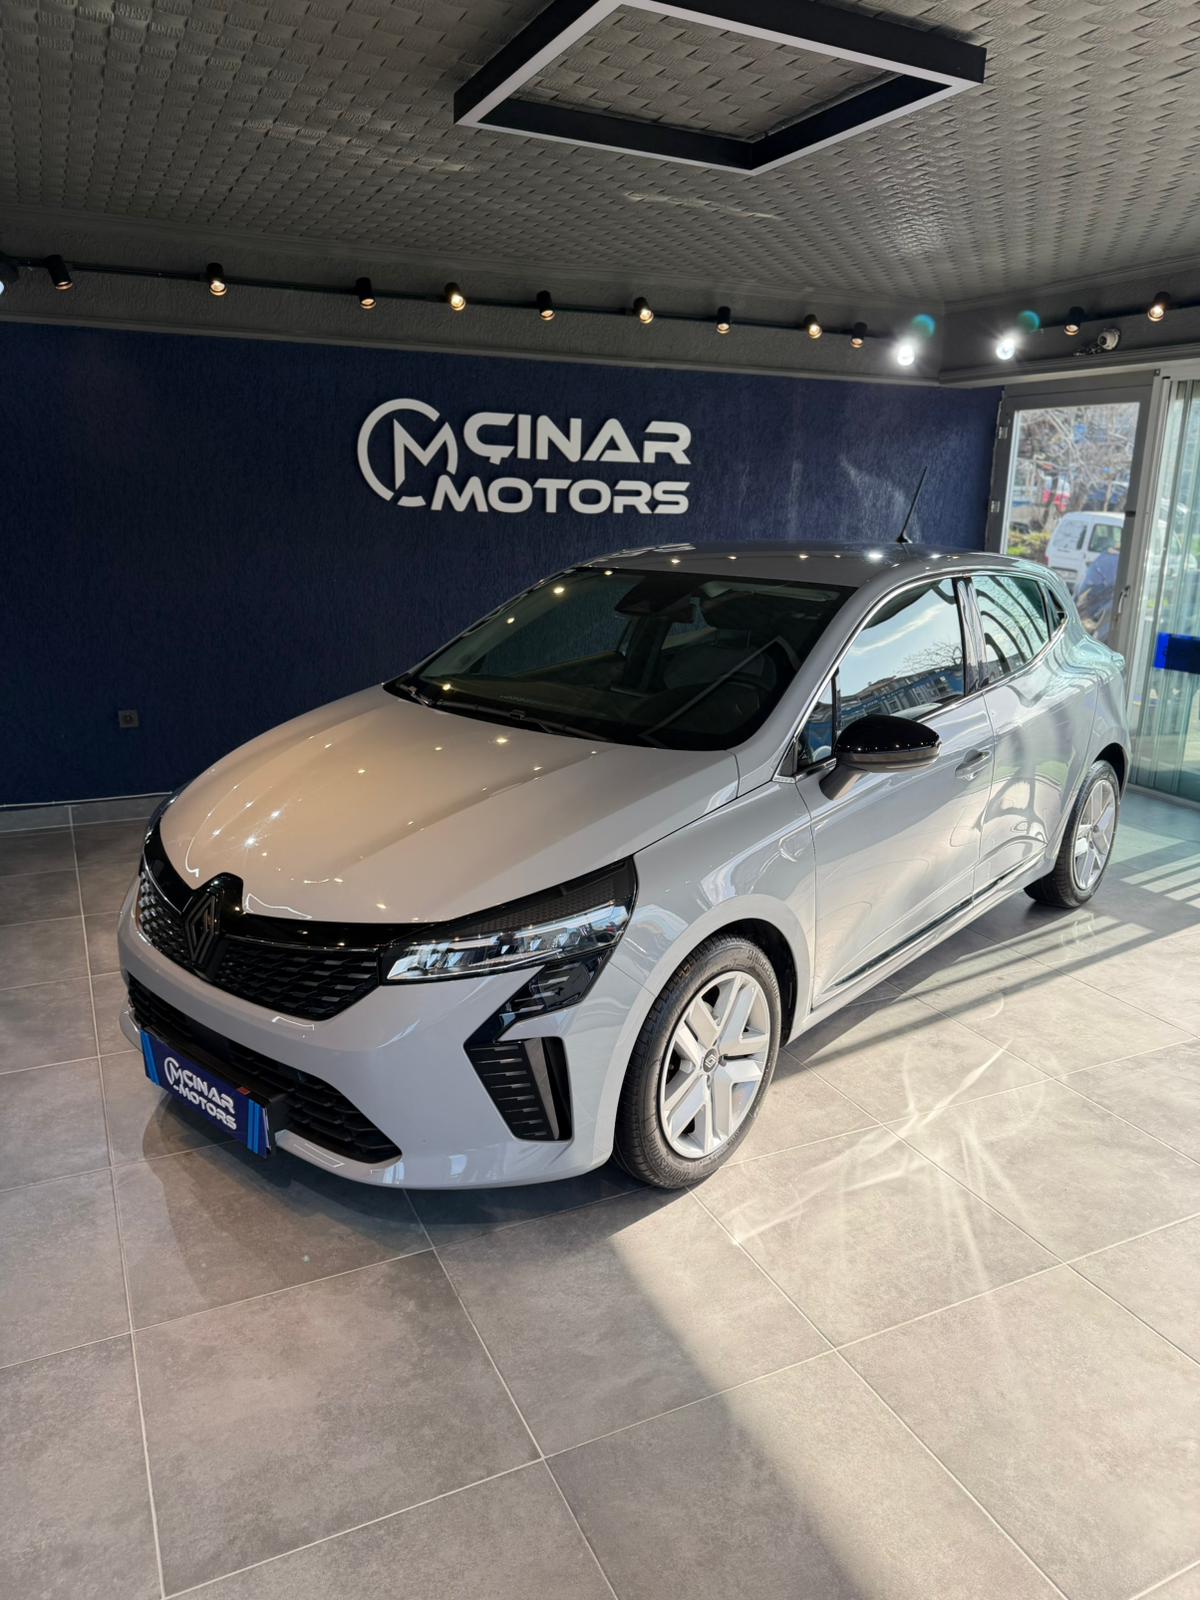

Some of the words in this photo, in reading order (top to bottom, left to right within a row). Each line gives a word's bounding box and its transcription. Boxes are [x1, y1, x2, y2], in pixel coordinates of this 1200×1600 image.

[463, 411, 692, 465] ÇINAR
[430, 474, 690, 514] MOTORS
[179, 1086, 237, 1130] MOTORS
